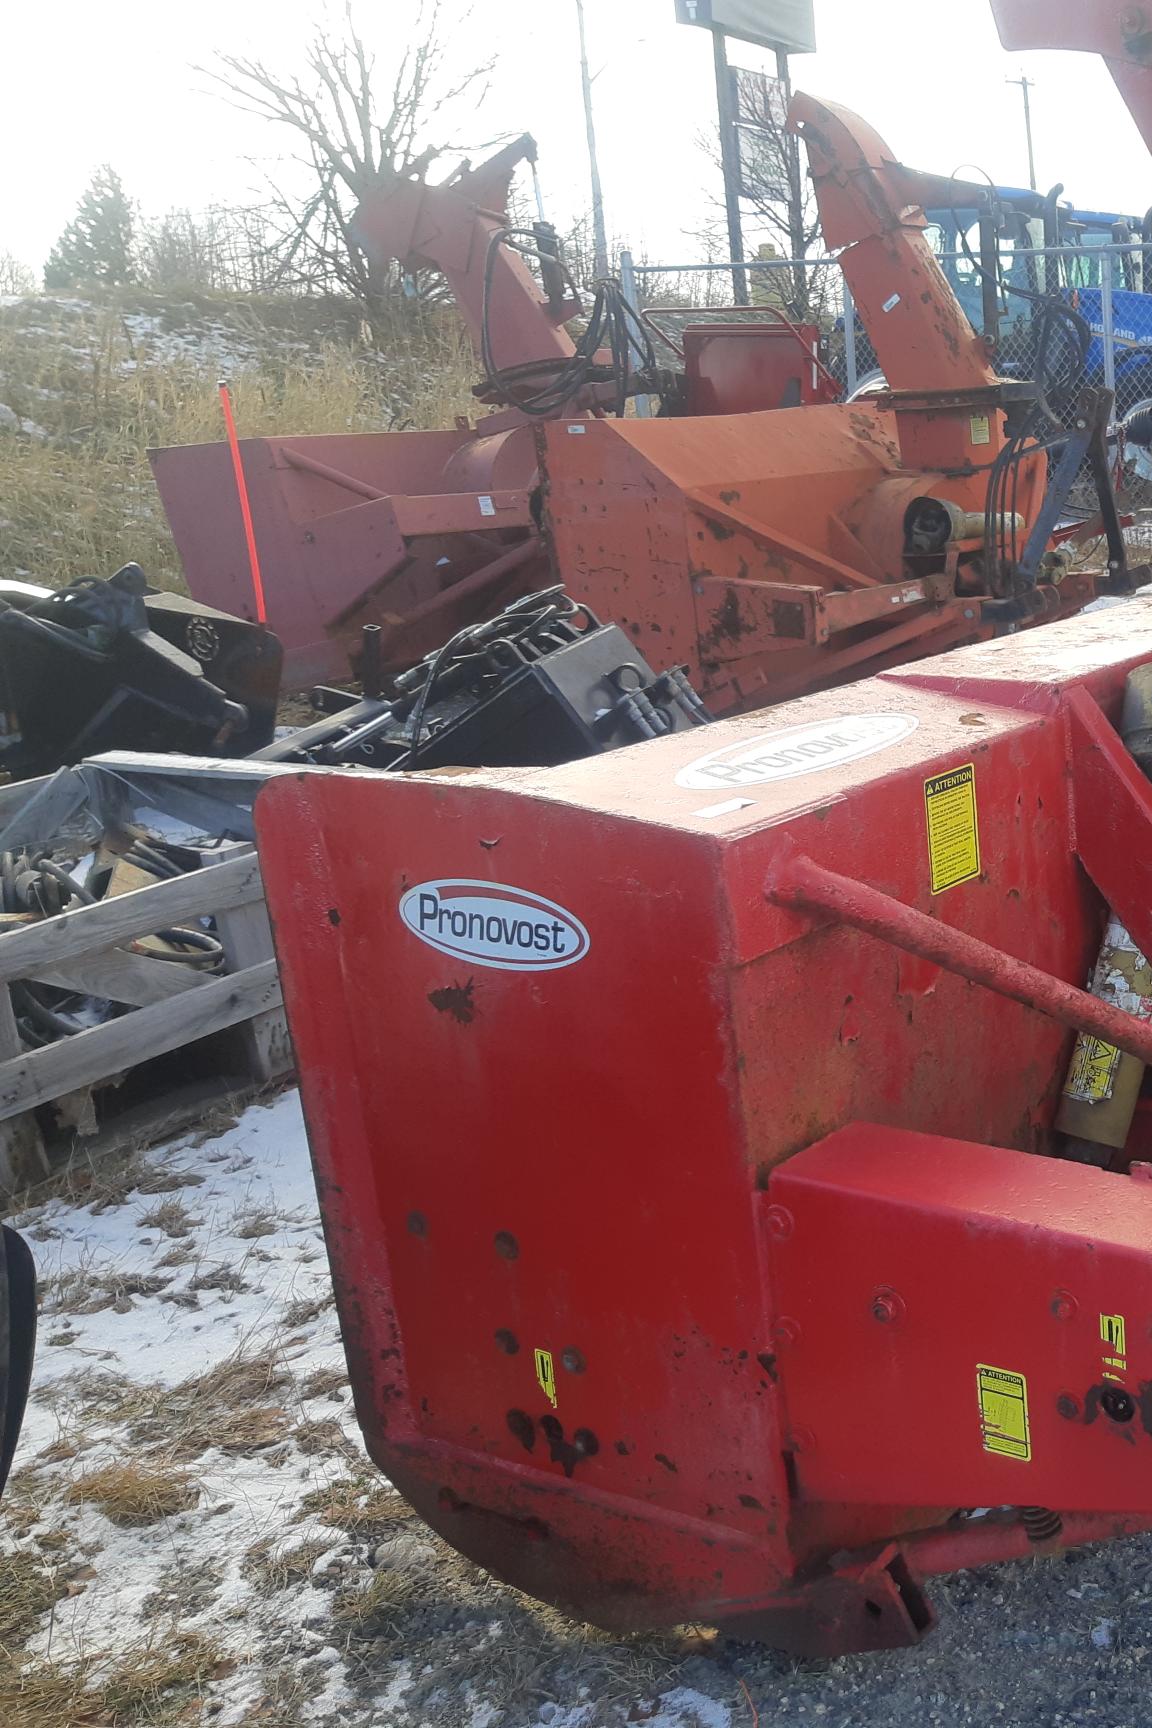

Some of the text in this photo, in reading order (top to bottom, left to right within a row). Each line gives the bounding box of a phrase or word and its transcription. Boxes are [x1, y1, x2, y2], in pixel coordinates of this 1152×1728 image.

[1090, 322, 1136, 340] HOAND
[934, 770, 972, 793] ATTENTION
[418, 893, 566, 953] Pronovost
[987, 1370, 1022, 1384] ATTENTION
